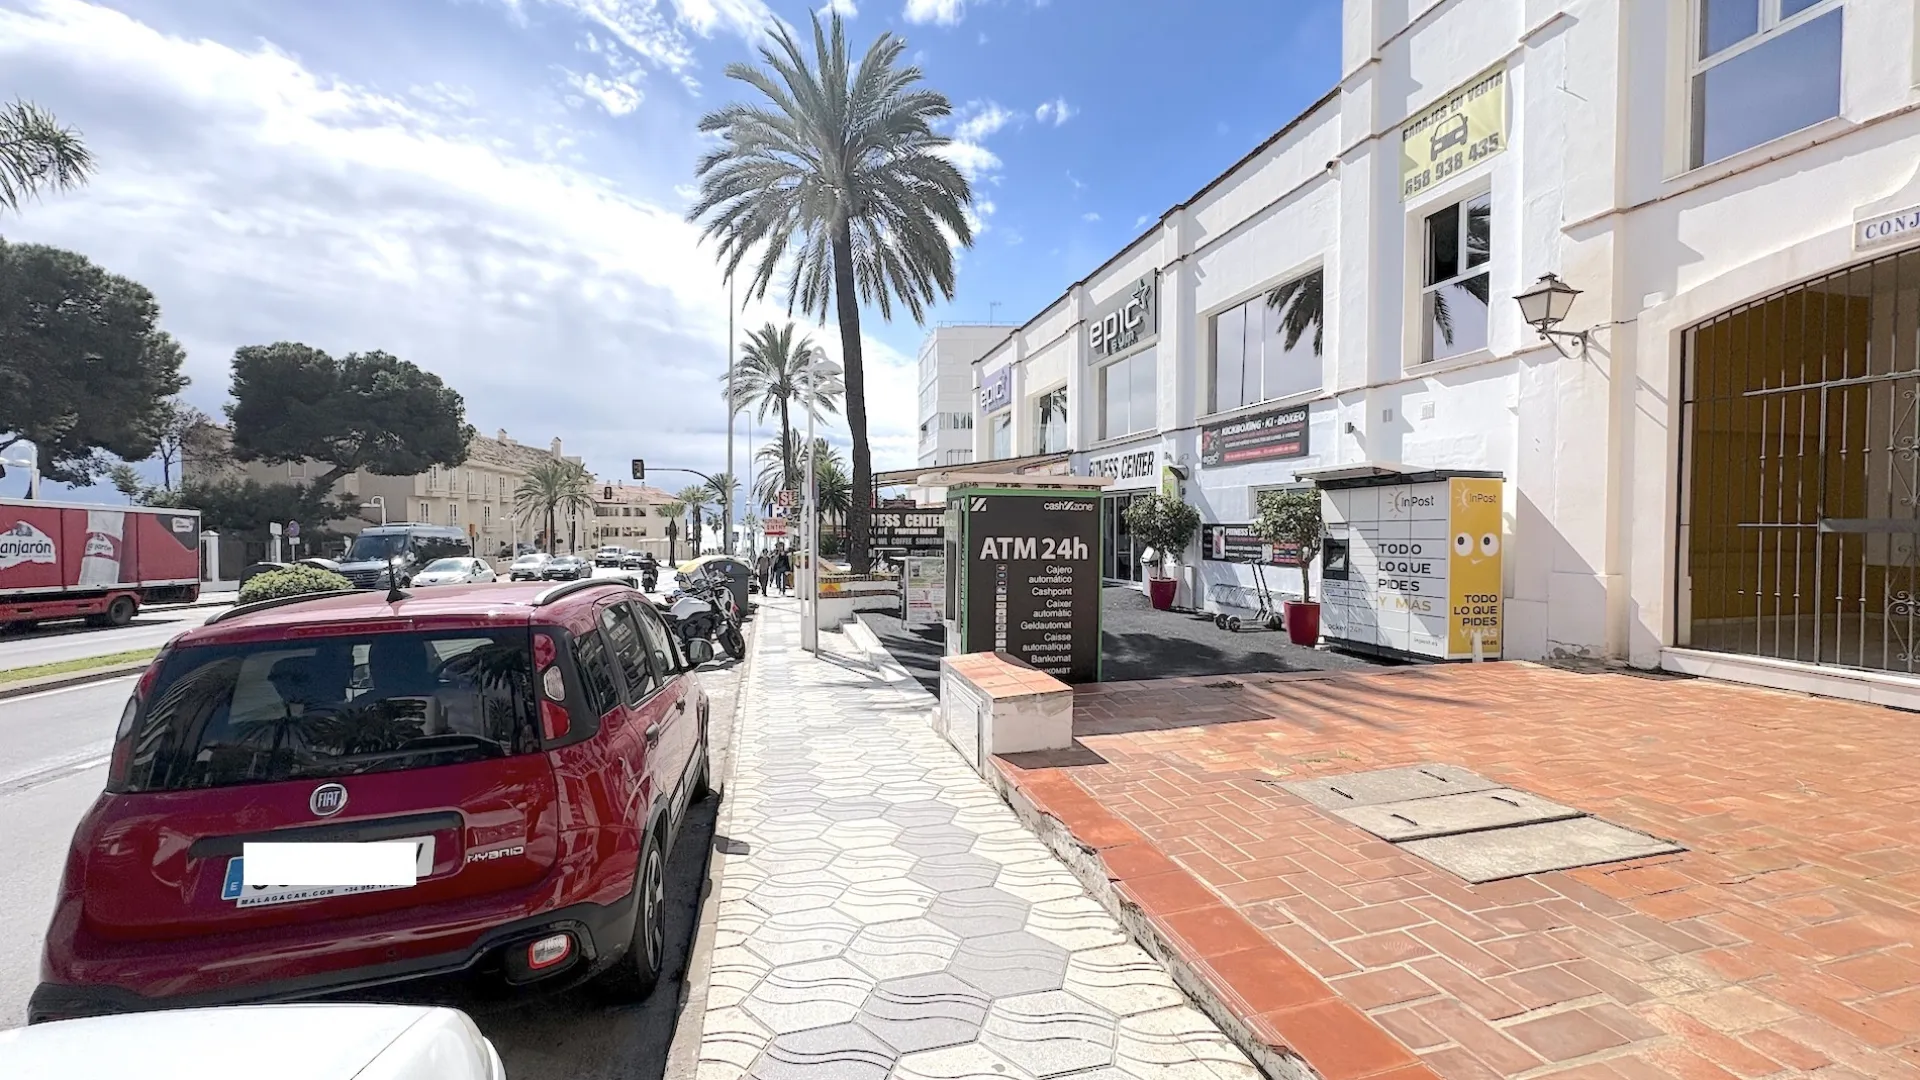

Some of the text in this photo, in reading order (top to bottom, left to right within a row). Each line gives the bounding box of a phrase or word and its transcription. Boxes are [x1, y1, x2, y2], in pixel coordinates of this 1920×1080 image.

[1450, 95, 1464, 112] EN
[1467, 71, 1504, 102] VENTA
[1405, 132, 1499, 194] 658 938 435
[1866, 212, 1920, 239] CONJ
[1090, 299, 1140, 354] epic
[1221, 419, 1261, 436] KICKBOXING
[1277, 411, 1306, 425] BOXEO
[1089, 451, 1155, 479] FITNESS CENTER
[871, 513, 900, 527] NESS
[891, 537, 913, 545] COFFEE
[0, 540, 51, 556] anjarón
[979, 536, 1089, 560] ATM 24h
[1378, 543, 1422, 555] TODO
[1046, 565, 1073, 575] Cajero
[1378, 561, 1431, 574] LO QUE
[1028, 574, 1073, 584] automático
[1378, 579, 1420, 592] PIDES
[1031, 587, 1073, 597] Cashpoint
[1046, 600, 1072, 608] Caixer
[1378, 596, 1387, 607] Y
[1464, 594, 1498, 604] TODO
[1453, 605, 1498, 615] LO QUE
[1020, 621, 1072, 630] Geldautomat
[1462, 617, 1498, 626] PIDES
[1324, 623, 1346, 632] ocker
[1044, 632, 1072, 641] Caisse
[1022, 643, 1072, 652] automatique
[1031, 654, 1072, 663] Bankomat
[317, 790, 340, 808] FIAT
[466, 846, 524, 863] HYBRID
[230, 881, 239, 891] E
[241, 889, 335, 905] MALAGACAR.COM
